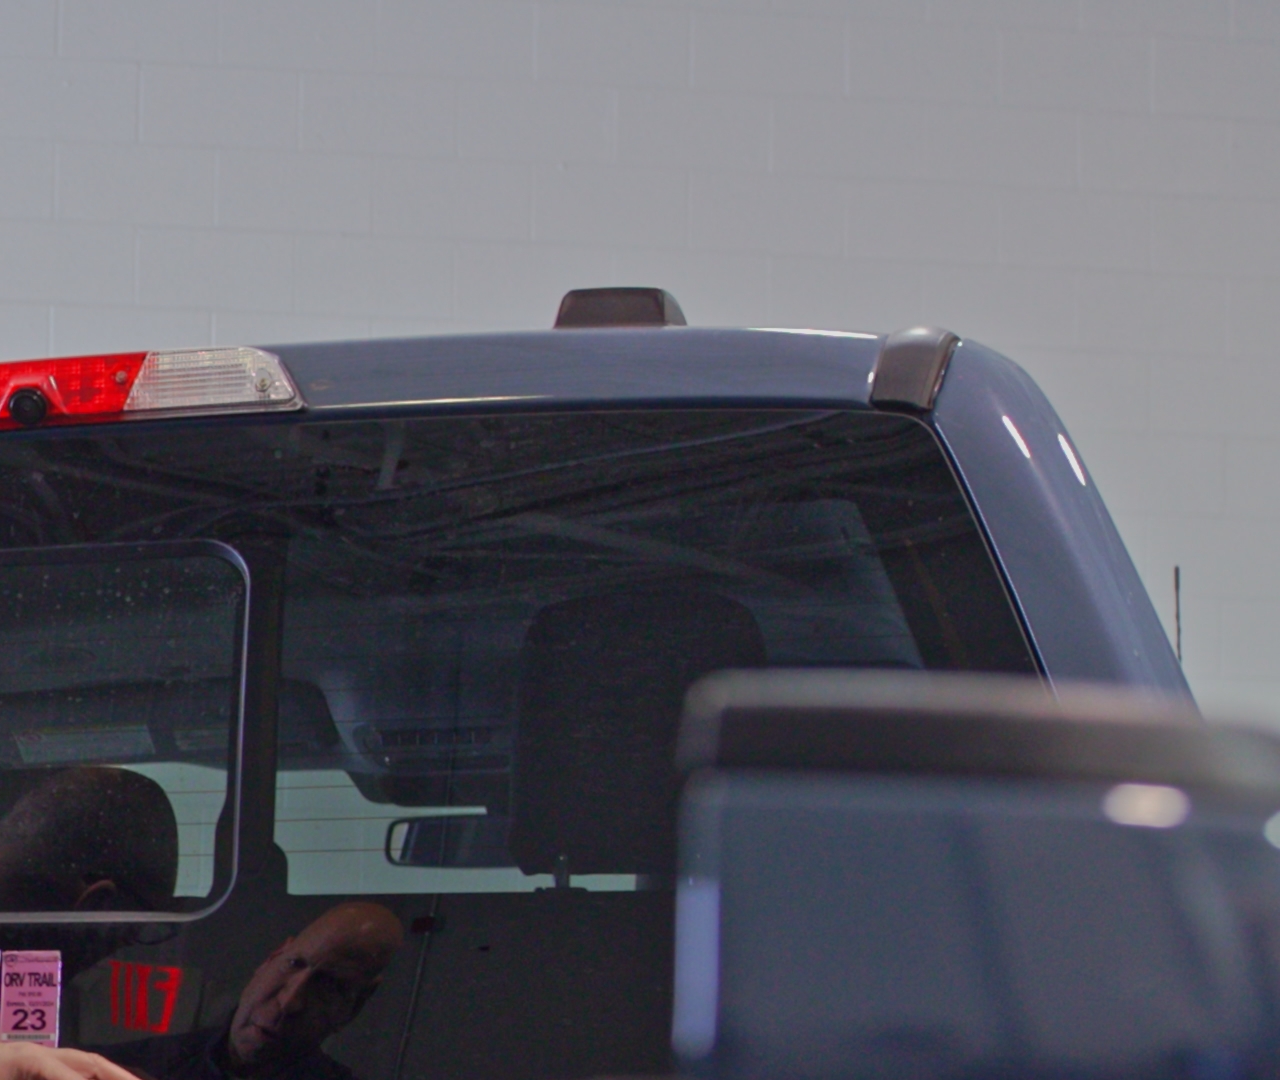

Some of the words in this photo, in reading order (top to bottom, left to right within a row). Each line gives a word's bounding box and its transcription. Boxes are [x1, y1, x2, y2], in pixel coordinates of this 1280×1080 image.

[4, 972, 26, 987] ORV
[28, 972, 57, 987] TRAIL
[12, 1009, 46, 1030] 23
